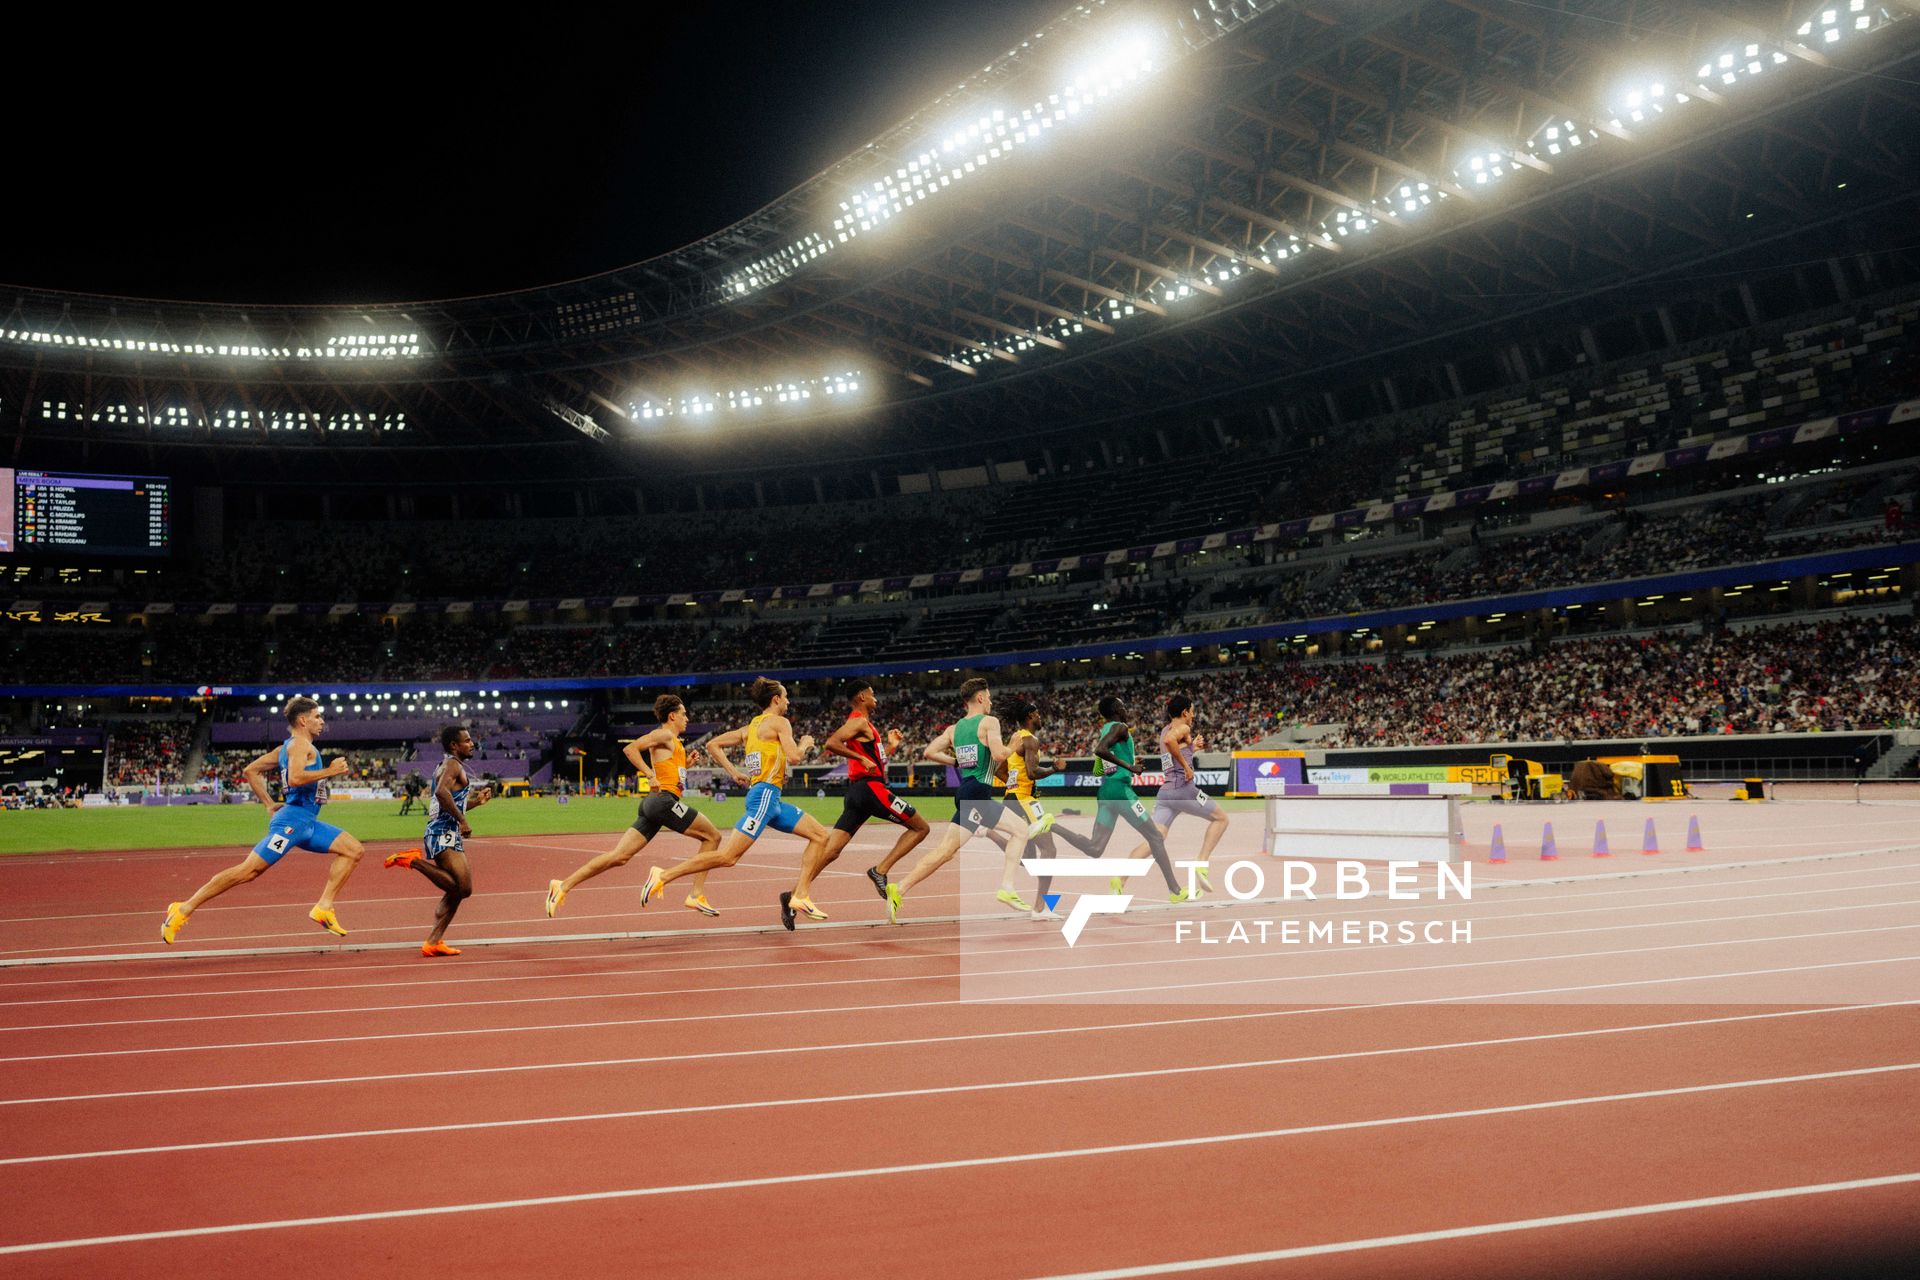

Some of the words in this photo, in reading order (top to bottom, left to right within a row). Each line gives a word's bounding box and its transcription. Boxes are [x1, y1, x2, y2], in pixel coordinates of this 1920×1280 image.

[1199, 793, 1206, 801] 5
[676, 804, 684, 813] 7
[895, 801, 904, 809] 2
[1136, 804, 1144, 813] 8
[747, 820, 755, 831] 3
[445, 834, 452, 844] 9
[274, 840, 284, 849] 4
